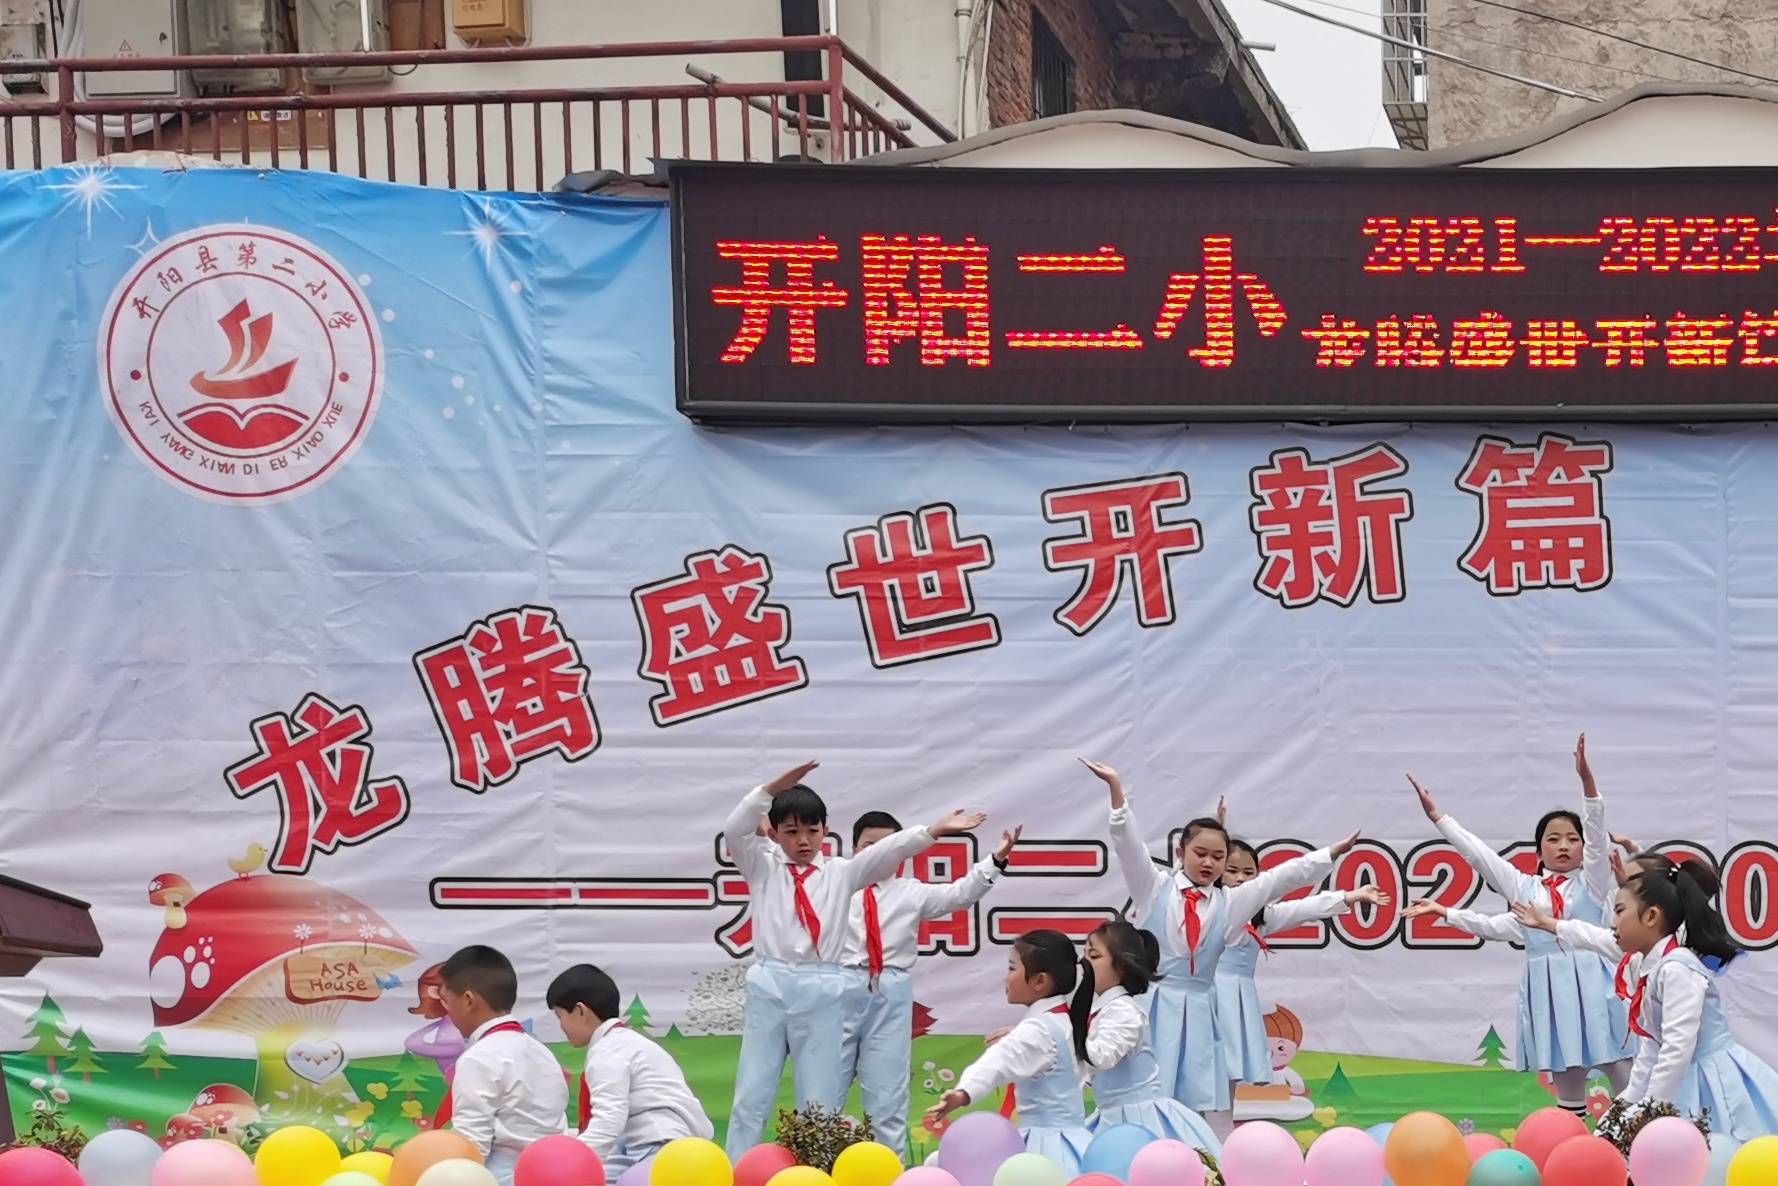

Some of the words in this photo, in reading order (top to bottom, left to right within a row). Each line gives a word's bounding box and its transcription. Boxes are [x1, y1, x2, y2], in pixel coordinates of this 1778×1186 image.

[131, 240, 358, 330] 开阳县第二小学
[710, 233, 1288, 369] 开阳二小
[223, 431, 1614, 876] 龙腾盛世开新篇
[310, 978, 368, 993] House
[320, 961, 360, 980] ASA
